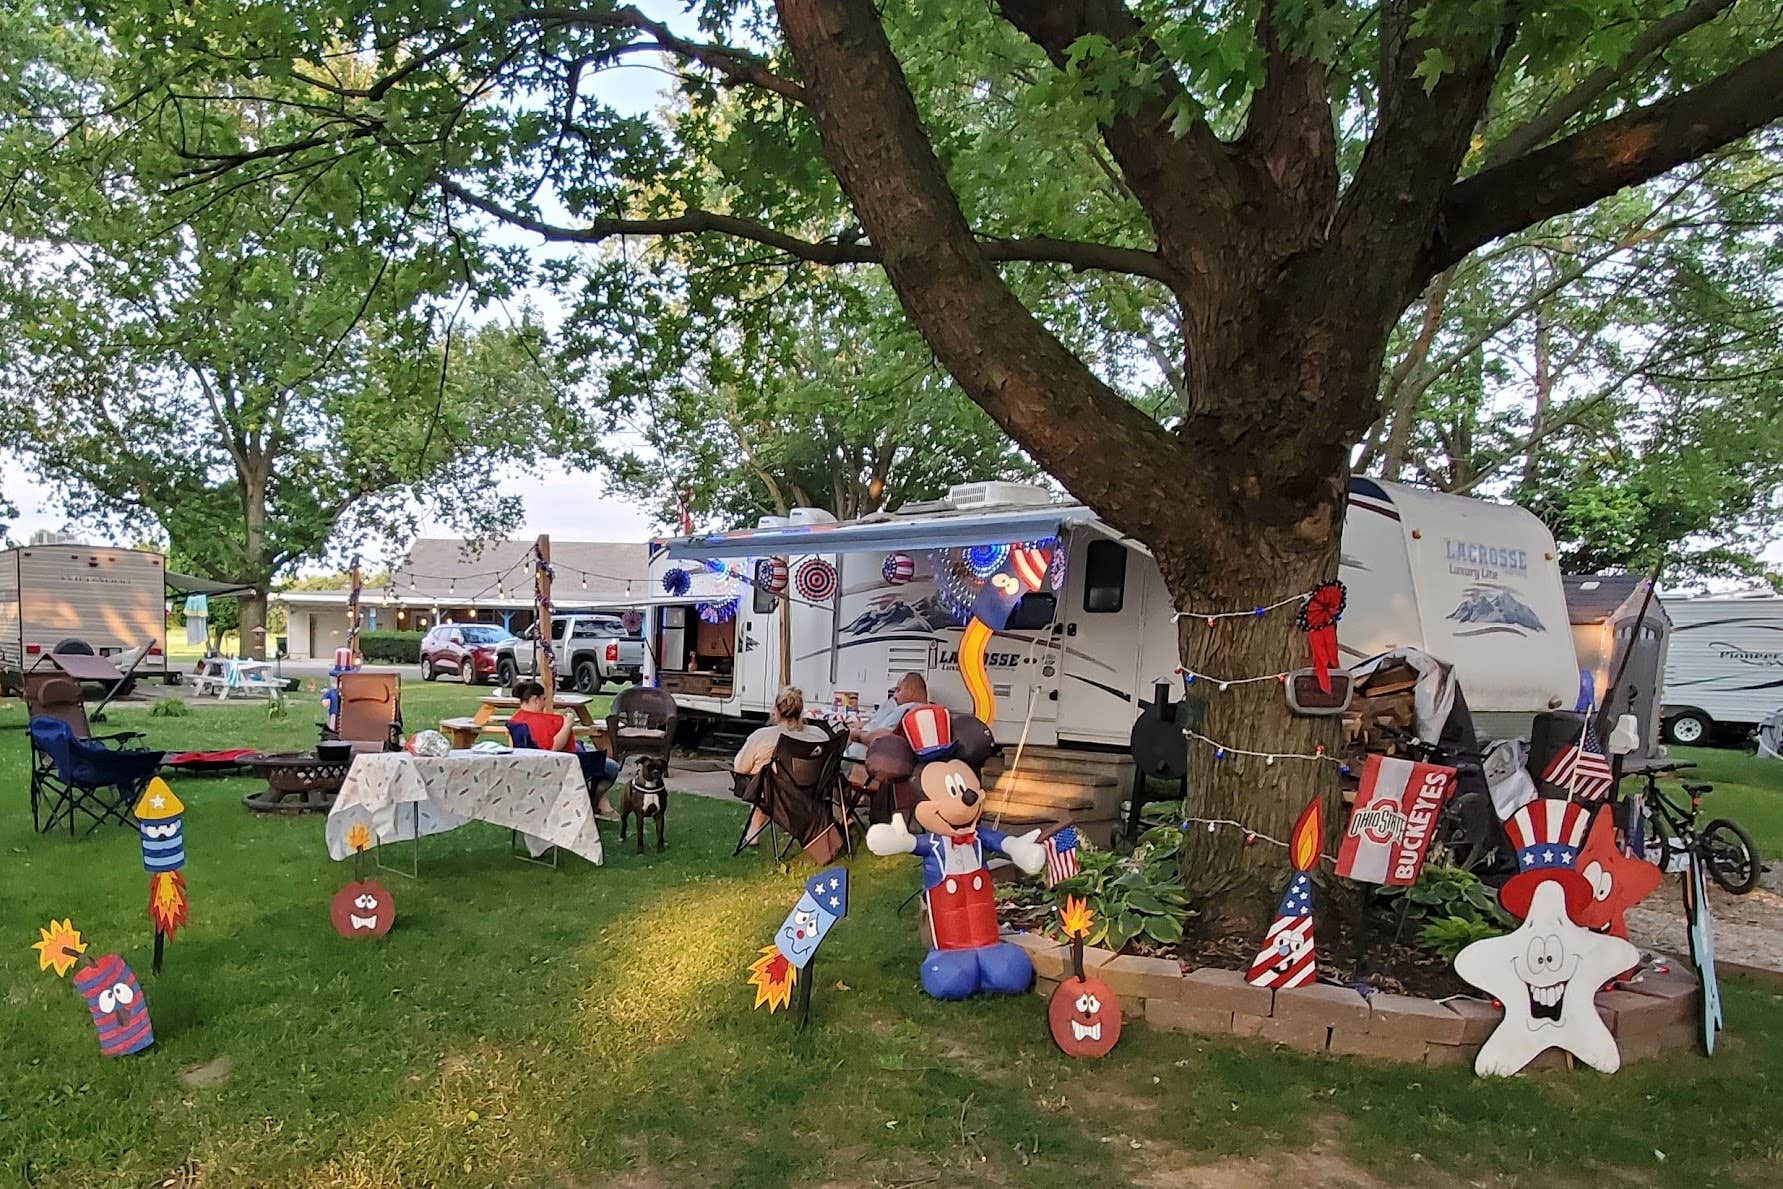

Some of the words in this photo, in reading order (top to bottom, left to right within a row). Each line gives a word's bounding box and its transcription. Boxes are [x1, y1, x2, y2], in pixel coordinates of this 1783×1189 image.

[1446, 540, 1527, 569] LACROSSE
[1448, 563, 1480, 580] Luxury
[939, 651, 1020, 667] LASSE
[1350, 812, 1380, 835] OHIO
[1394, 772, 1448, 879] BUCKEYES
